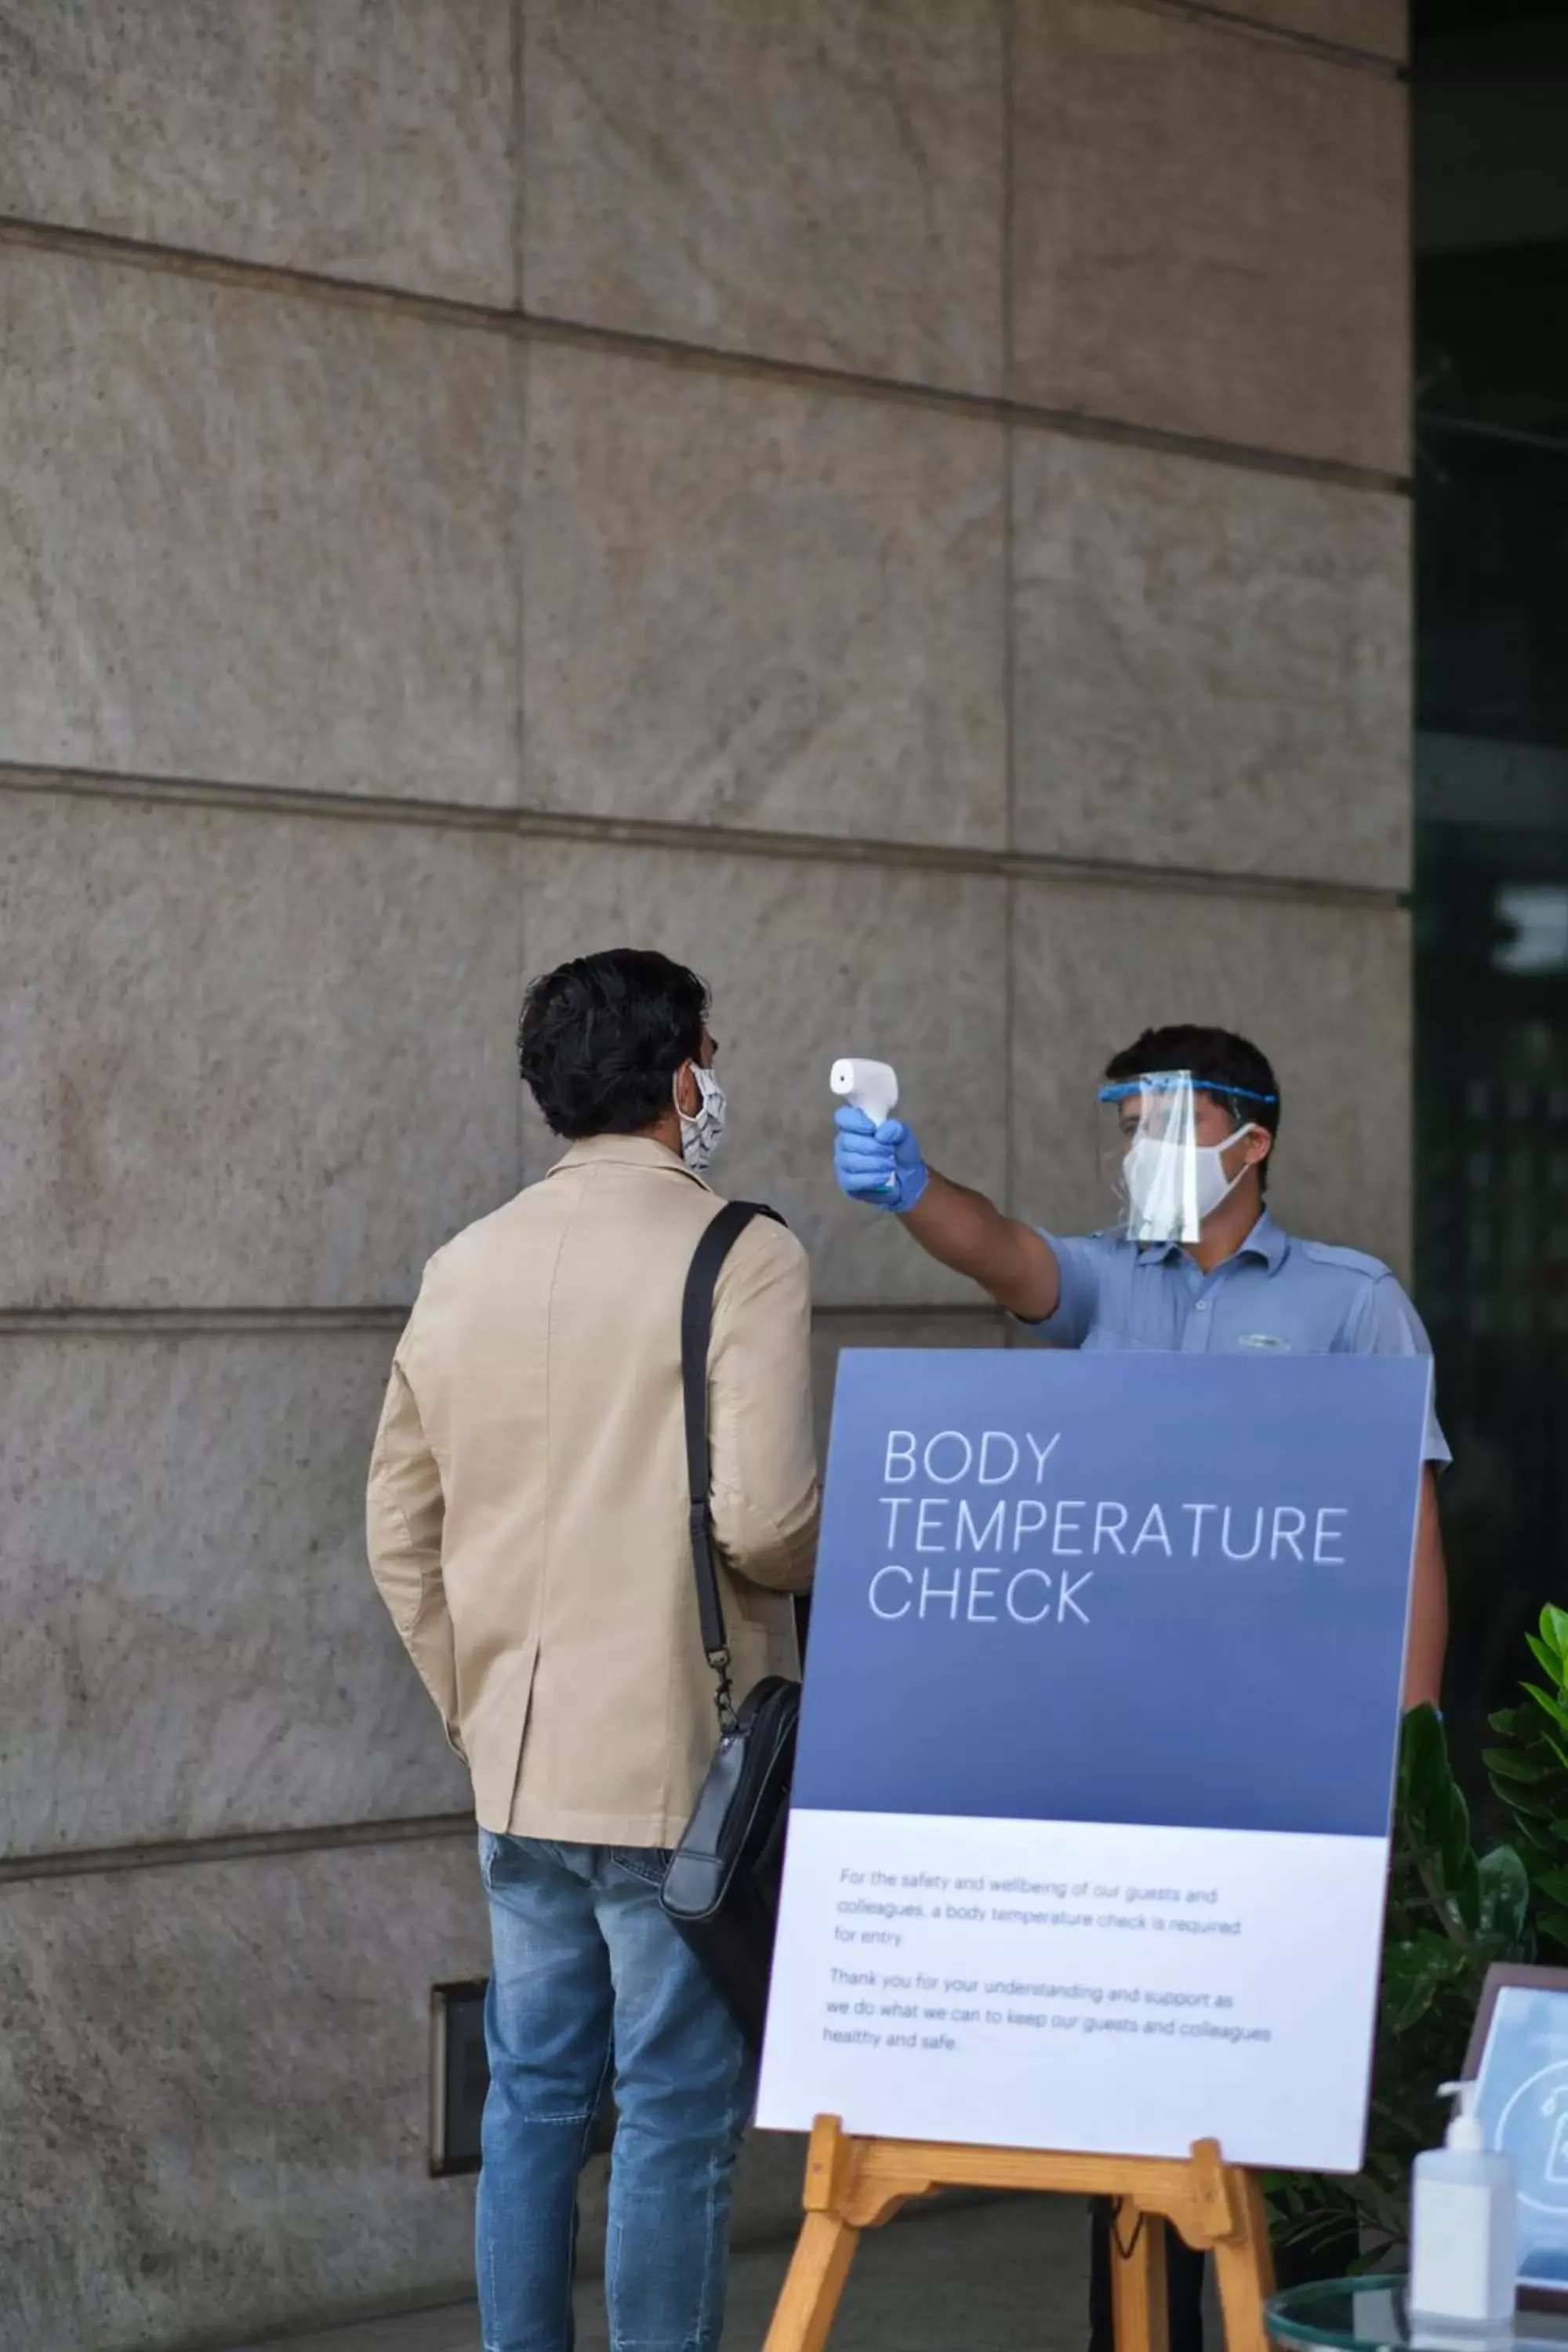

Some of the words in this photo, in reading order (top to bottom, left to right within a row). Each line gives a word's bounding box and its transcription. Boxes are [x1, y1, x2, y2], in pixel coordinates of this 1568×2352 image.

[883, 1430, 1061, 1485] BODY
[879, 1497, 1348, 1565] TEMPERATURE
[868, 1565, 1094, 1624] CHECK
[840, 1867, 866, 1885] For
[870, 1870, 897, 1886] the
[902, 1871, 949, 1891] safety
[954, 1876, 985, 1891] and
[990, 1877, 1068, 1899] wellbeing
[1071, 1880, 1088, 1897] of
[1093, 1884, 1120, 1898] our
[1125, 1886, 1180, 1903] guests
[1185, 1888, 1218, 1904] and
[834, 1926, 857, 1943] for
[931, 1905, 941, 1919] a
[946, 1904, 986, 1921] body
[992, 1907, 1092, 1927] temperature
[1096, 1913, 1146, 1929] check
[1152, 1915, 1165, 1930] is
[1169, 1918, 1242, 1935] required
[830, 1966, 877, 1986] Thank
[881, 1975, 911, 1991] you
[916, 1971, 939, 1990] for
[943, 1979, 978, 1993] your
[985, 1979, 1103, 2005] understanding
[1107, 1988, 1140, 2002] and
[1145, 1990, 1209, 2007] support
[1214, 1994, 1232, 2008] as
[822, 2026, 880, 2048] healthy
[886, 2031, 916, 2048] and
[826, 2001, 850, 2014] we
[853, 1999, 875, 2015] do
[880, 2000, 919, 2019] what
[924, 2007, 947, 2020] we
[950, 2008, 980, 2022] can
[985, 2009, 1002, 2023] to
[1007, 2009, 1048, 2029] keep
[1051, 2015, 1079, 2029] our
[1083, 2016, 1138, 2034] guests
[1143, 2019, 1174, 2034] and
[1179, 2020, 1272, 2044] colleagues
